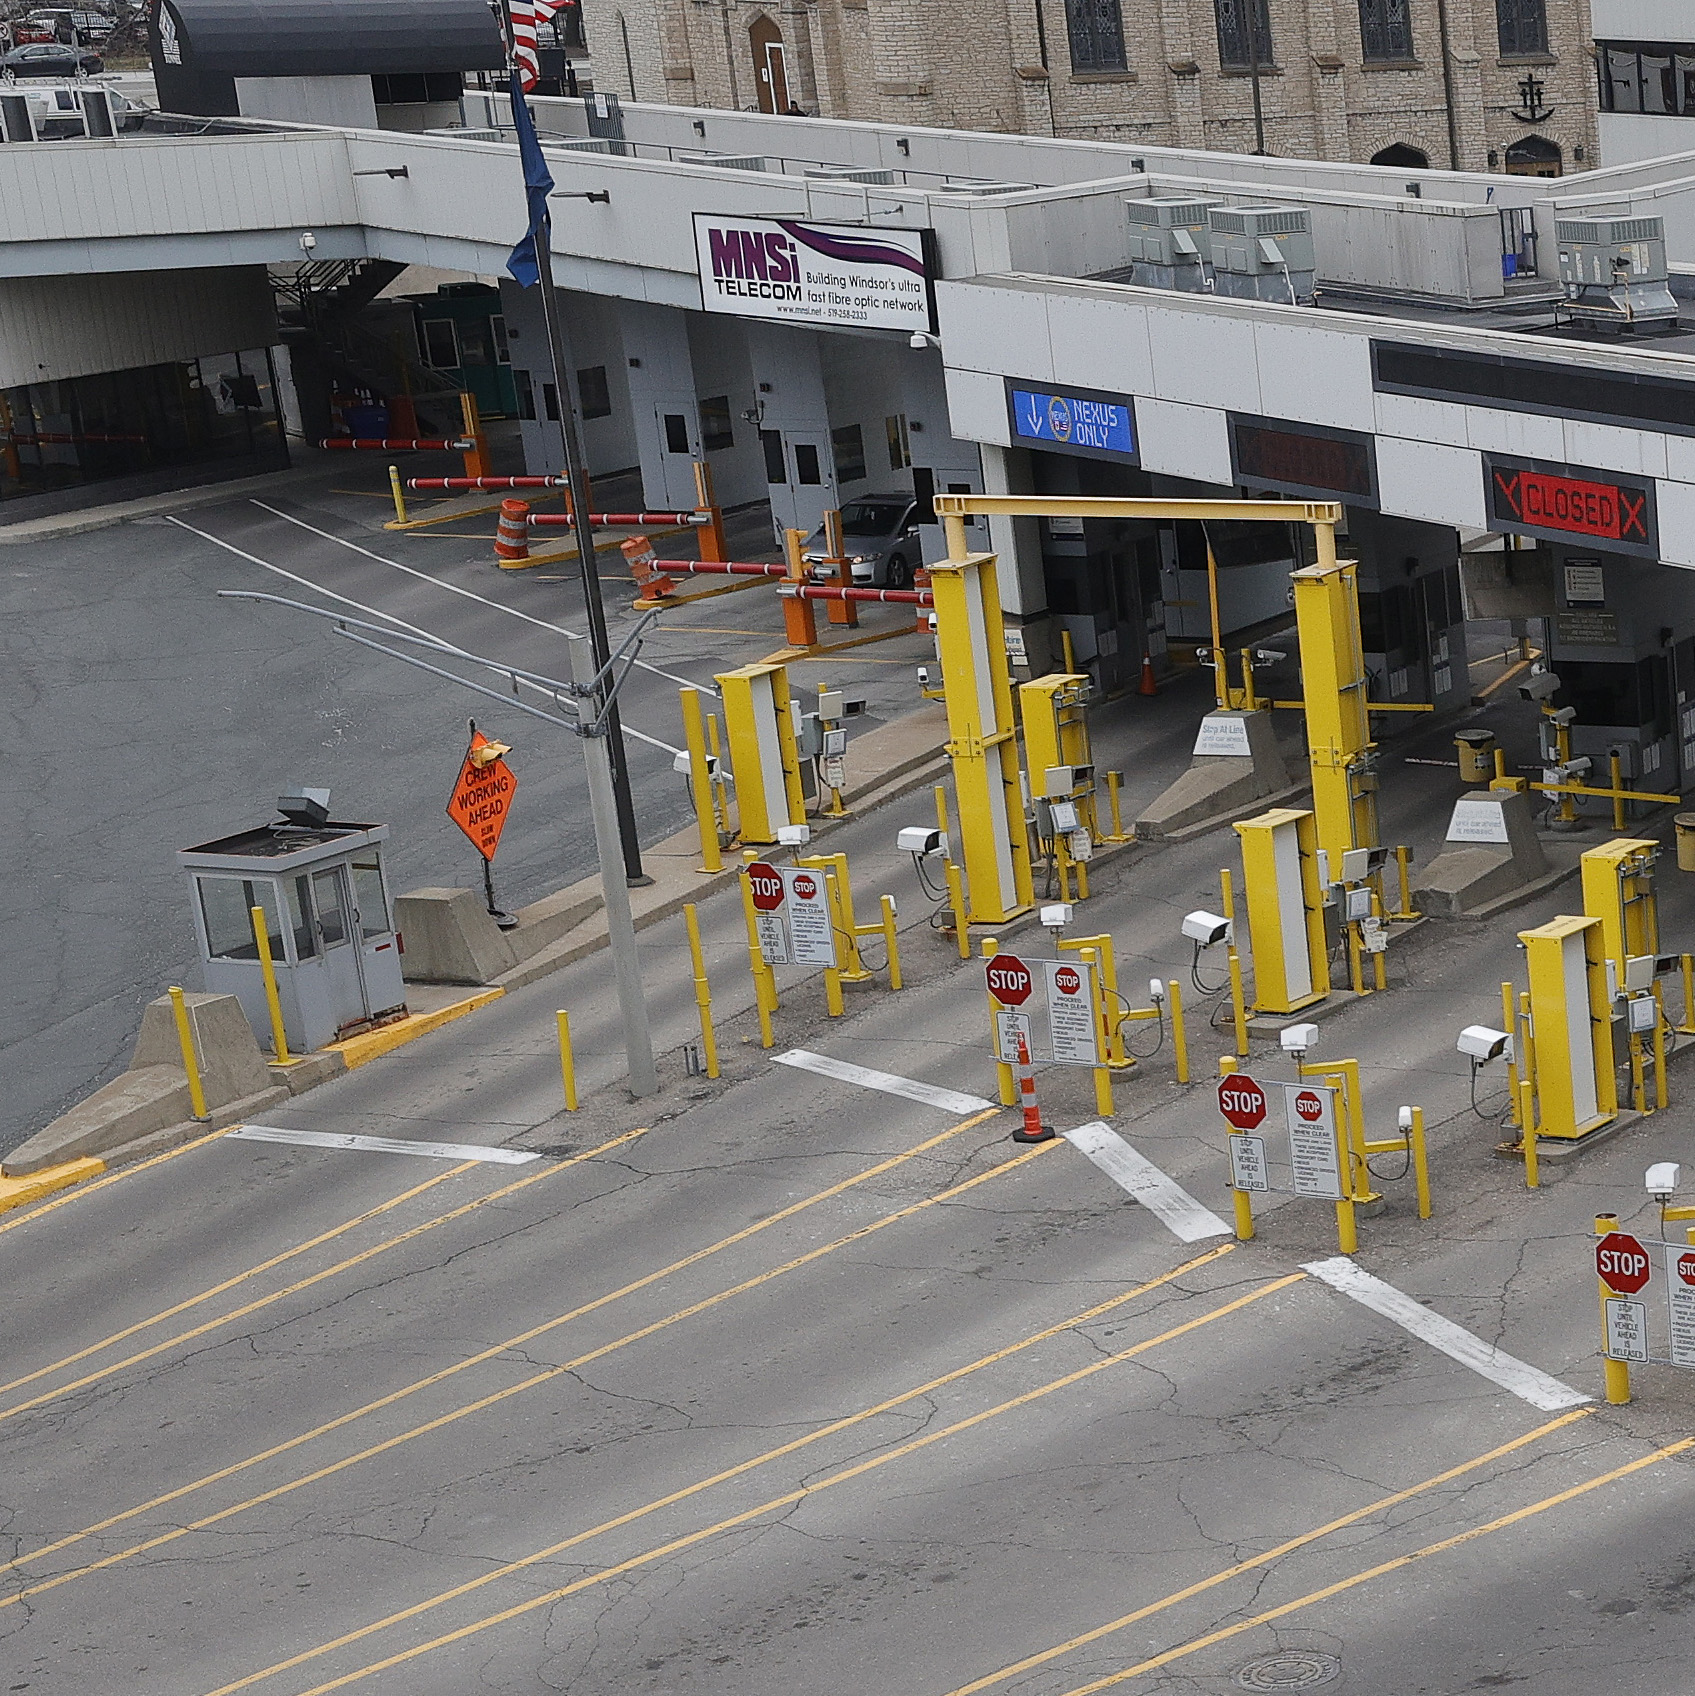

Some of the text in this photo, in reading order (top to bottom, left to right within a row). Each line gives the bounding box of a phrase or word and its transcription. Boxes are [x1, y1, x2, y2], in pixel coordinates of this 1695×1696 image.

[708, 228, 800, 283] MNSi
[714, 279, 801, 301] TELECOM
[807, 273, 920, 292] Building Windsor's ultra
[808, 291, 923, 313] fast fibre optic network
[1074, 400, 1117, 426] NEXUS
[1077, 423, 1108, 447] ONLY
[1527, 484, 1614, 527] CLOSED
[466, 763, 496, 786] CREW
[458, 776, 508, 811] WORKING
[469, 799, 503, 827] AHEAD
[795, 882, 814, 893] STOP
[990, 969, 1027, 991] STOP
[1057, 975, 1078, 987] STOP
[1222, 1090, 1262, 1113] STOP
[1298, 1100, 1320, 1113] STOP
[1600, 1250, 1645, 1276] STOP
